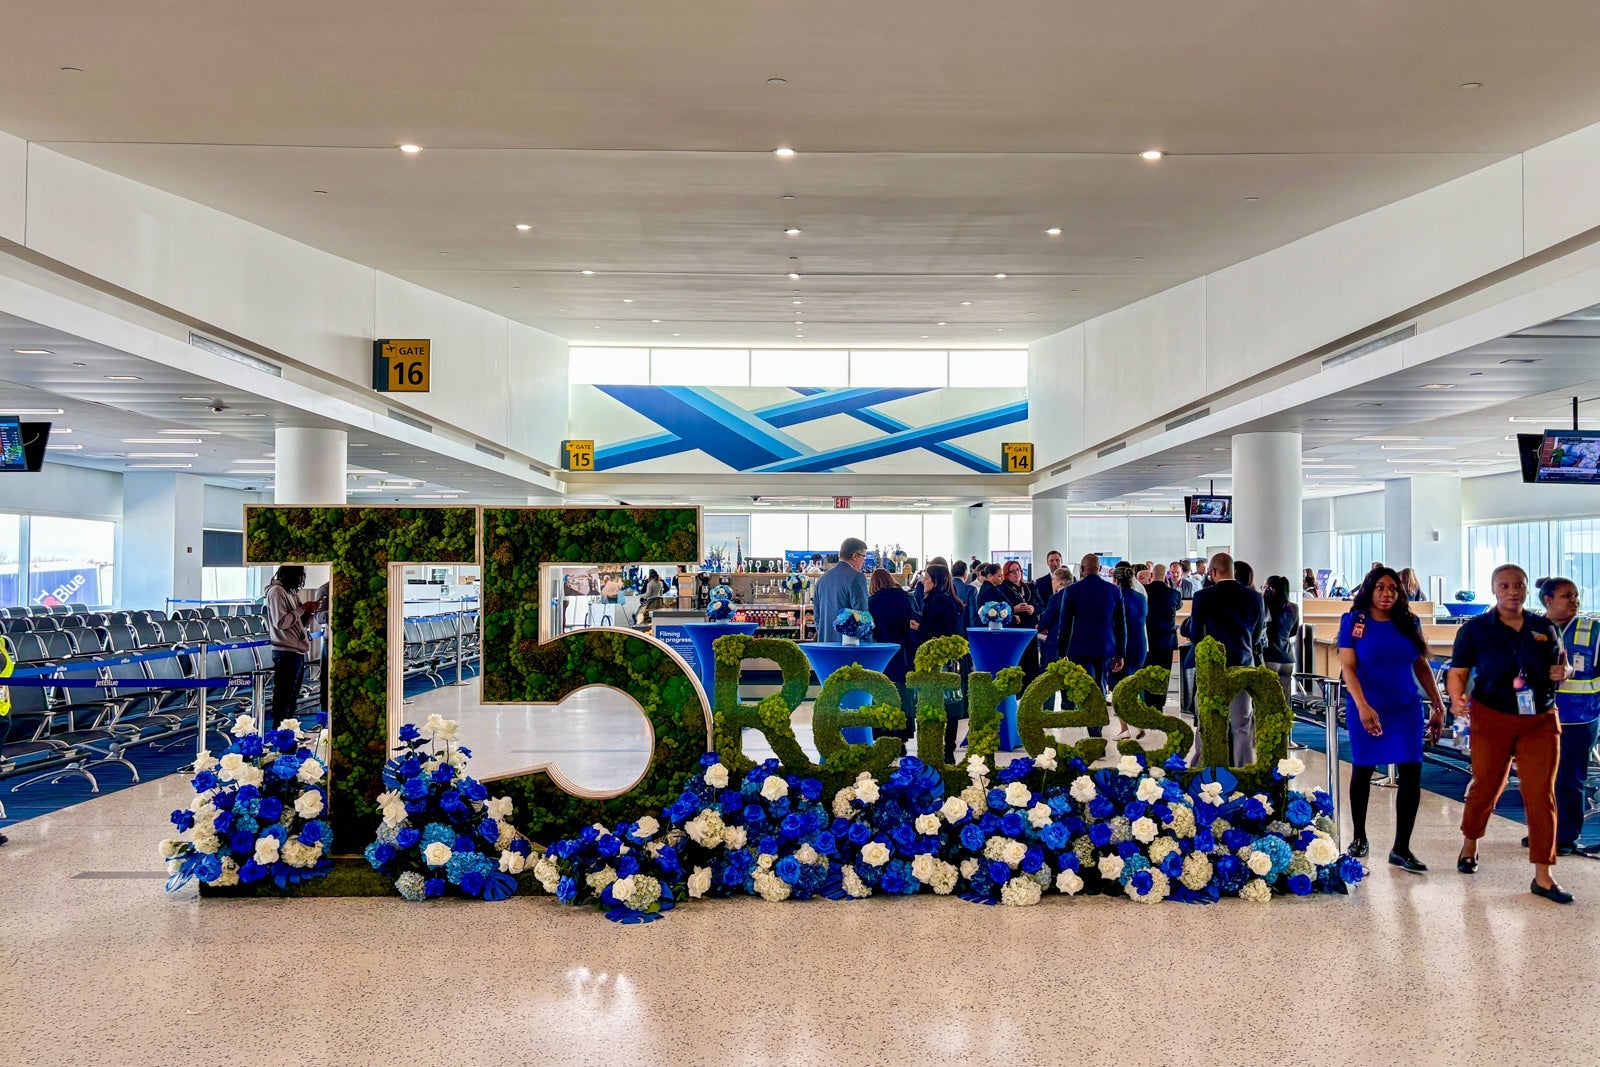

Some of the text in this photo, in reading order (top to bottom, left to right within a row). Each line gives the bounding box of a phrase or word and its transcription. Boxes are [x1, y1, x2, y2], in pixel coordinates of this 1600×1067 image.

[398, 346, 425, 356] GATE
[393, 361, 424, 385] 16
[572, 452, 590, 467] 15
[1010, 455, 1029, 469] 14
[835, 497, 849, 509] EXIT
[33, 574, 86, 604] I Blue
[659, 630, 681, 638] Filming
[228, 679, 252, 687] jetBlue
[243, 504, 1293, 856] T5 Refresh
